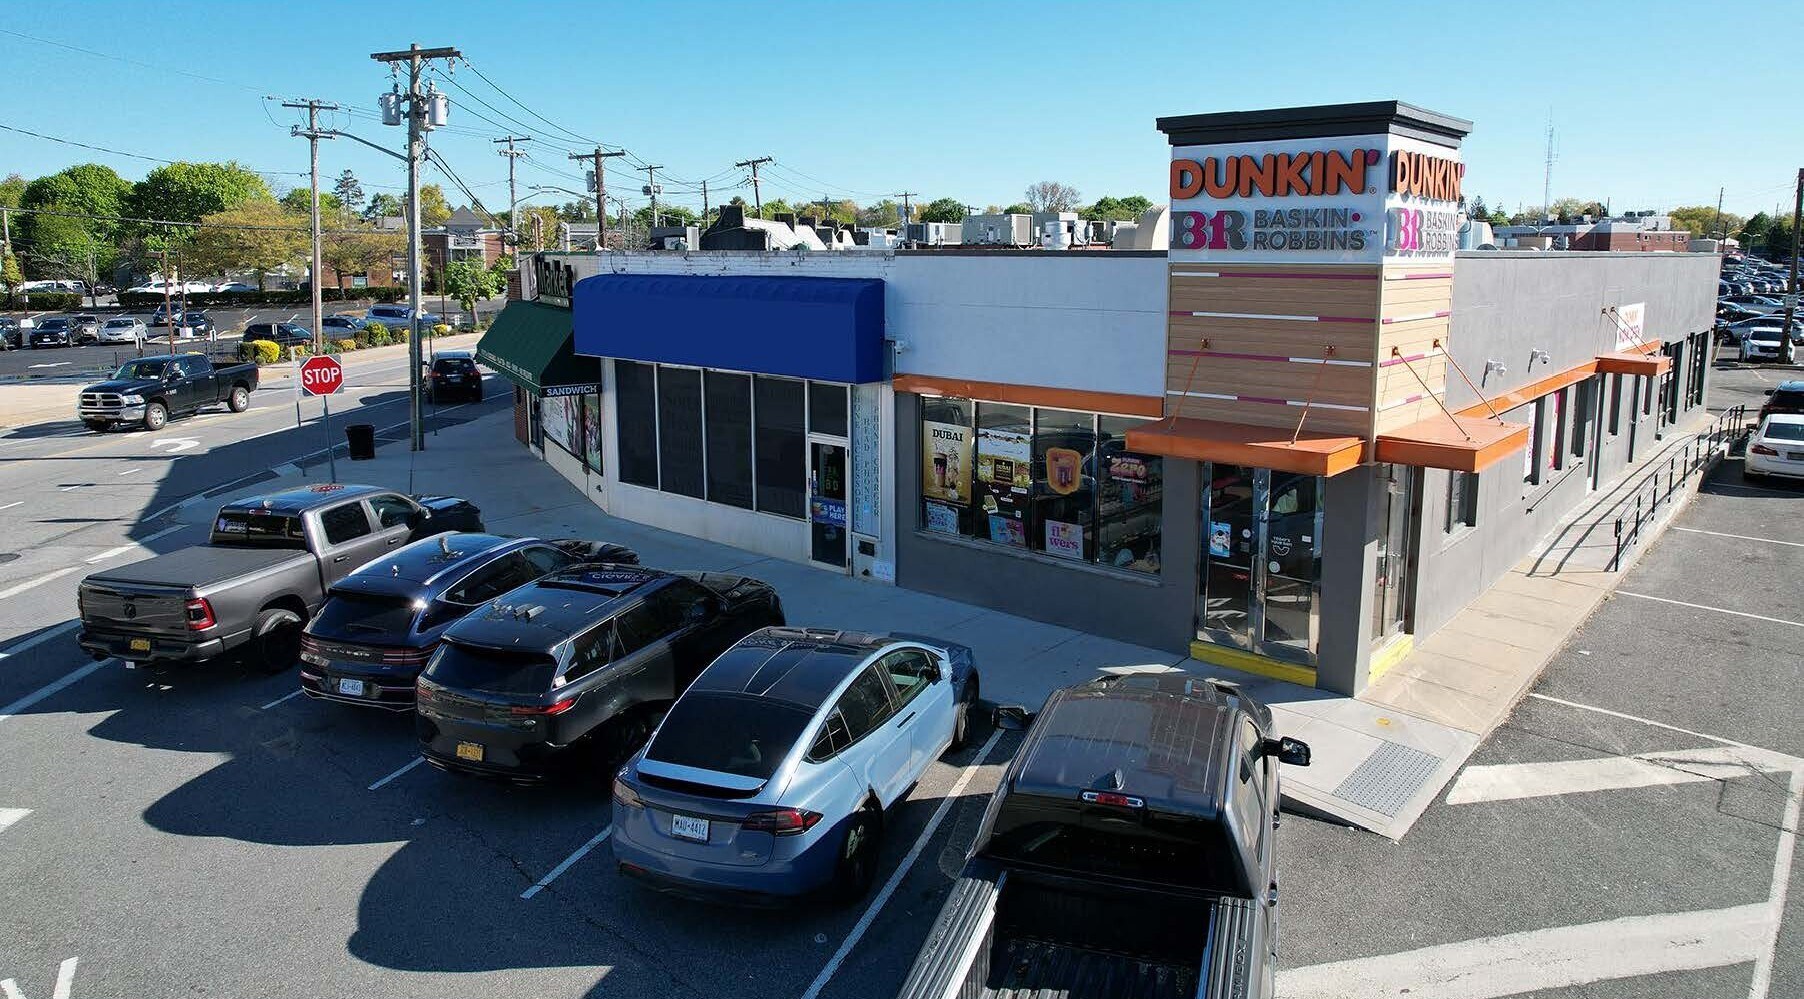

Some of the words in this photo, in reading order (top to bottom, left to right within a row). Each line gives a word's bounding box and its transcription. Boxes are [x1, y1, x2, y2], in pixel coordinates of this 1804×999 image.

[1170, 148, 1379, 199] DUNKIN'
[1253, 230, 1366, 251] ROBBINS
[304, 365, 340, 385] STOP
[546, 384, 598, 398] SANDWICH
[932, 428, 964, 442] DUBAI
[829, 504, 846, 514] PLAY
[829, 511, 846, 521] HERE
